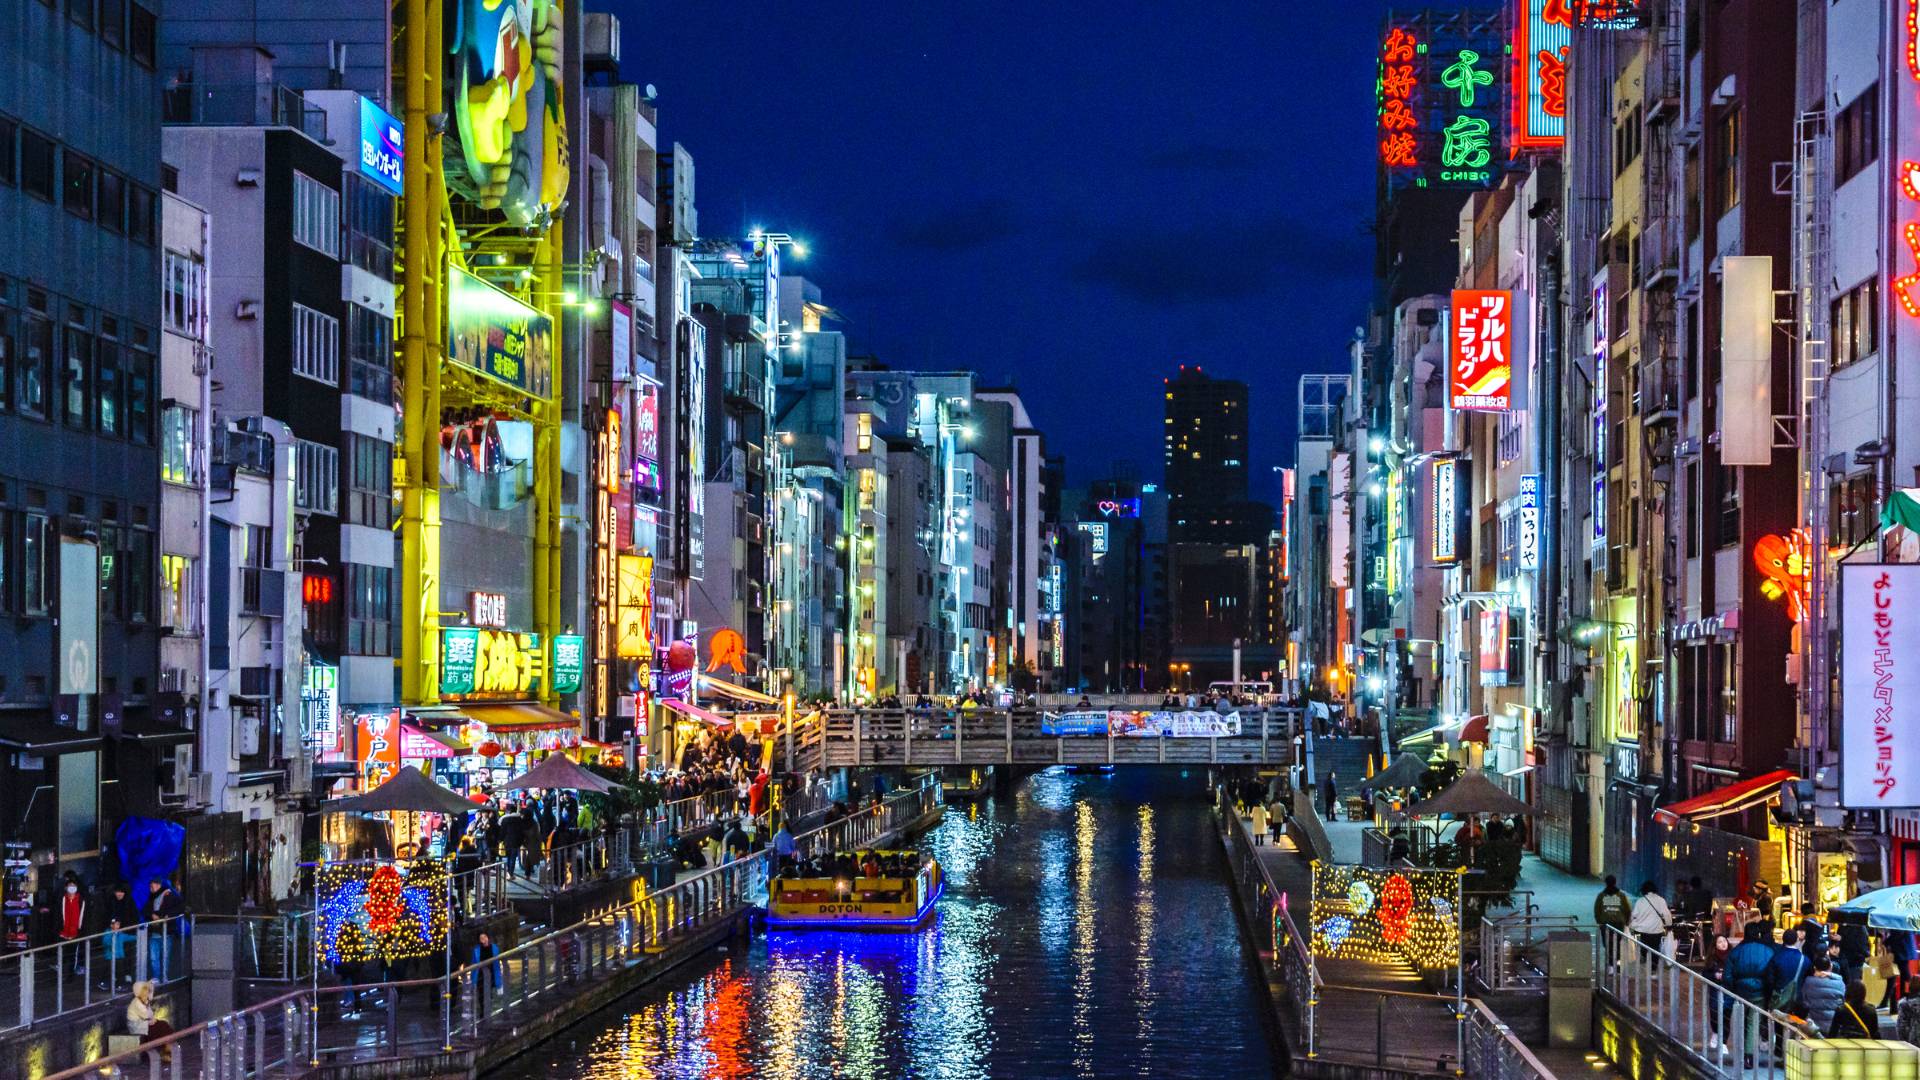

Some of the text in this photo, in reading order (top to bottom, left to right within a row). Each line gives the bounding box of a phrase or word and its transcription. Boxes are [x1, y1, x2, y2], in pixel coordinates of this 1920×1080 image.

[1382, 28, 1417, 167] お好み焼
[1441, 172, 1490, 181] CHIBO
[1458, 308, 1480, 379] ドラッグ
[1480, 296, 1505, 363] ツルハ
[1522, 510, 1536, 567] いろりや
[447, 637, 475, 664] 薬
[556, 643, 580, 667] 薬
[819, 905, 862, 913] DOTON
